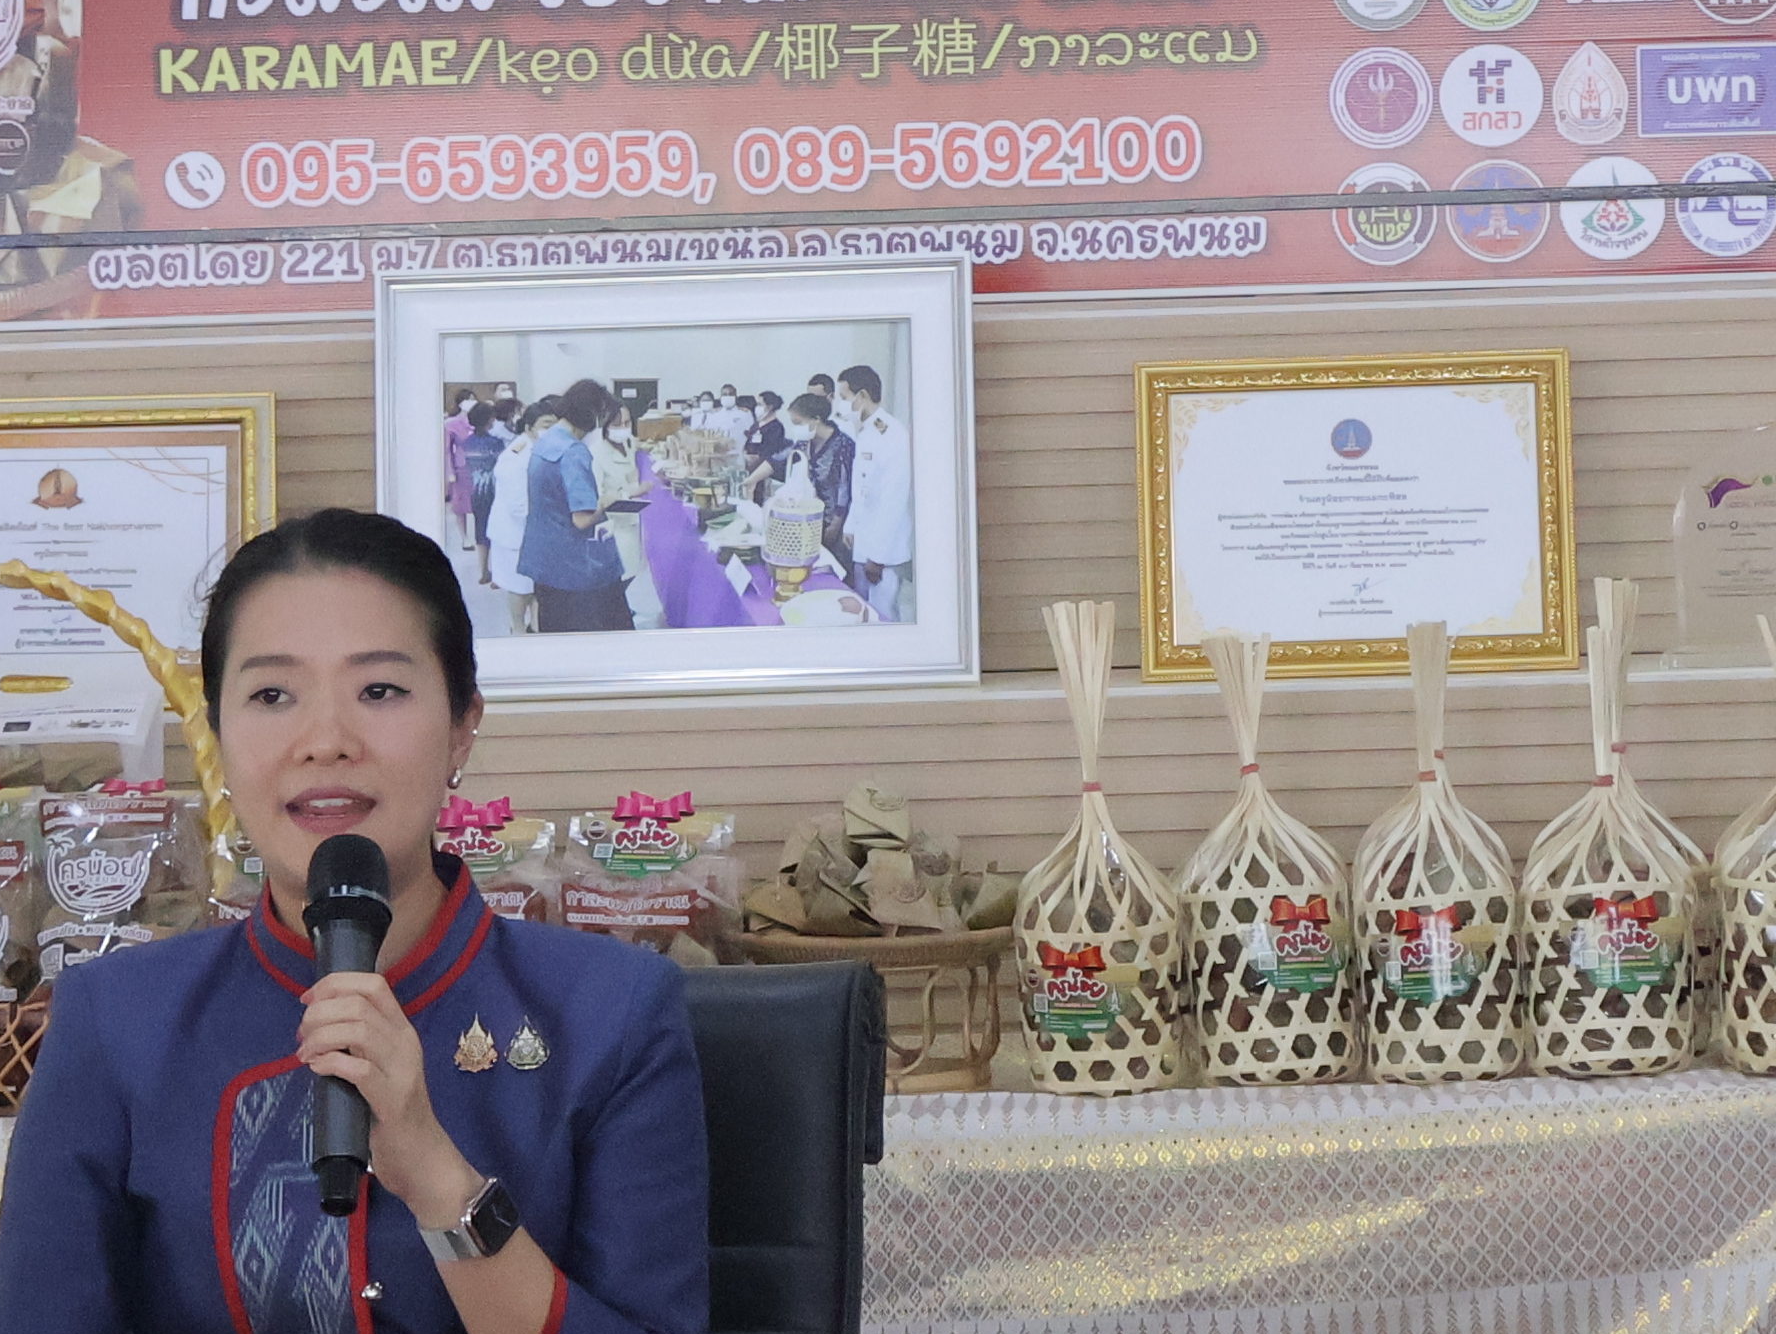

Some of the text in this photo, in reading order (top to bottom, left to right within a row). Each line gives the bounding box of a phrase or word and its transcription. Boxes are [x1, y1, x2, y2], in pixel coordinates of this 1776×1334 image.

[1667, 74, 1757, 104] บพท
[1462, 111, 1523, 132] สกสว
[242, 116, 1203, 204] 095-6593959, 089-5692100
[94, 244, 269, 284] ผลตโดย
[286, 241, 360, 279] 221
